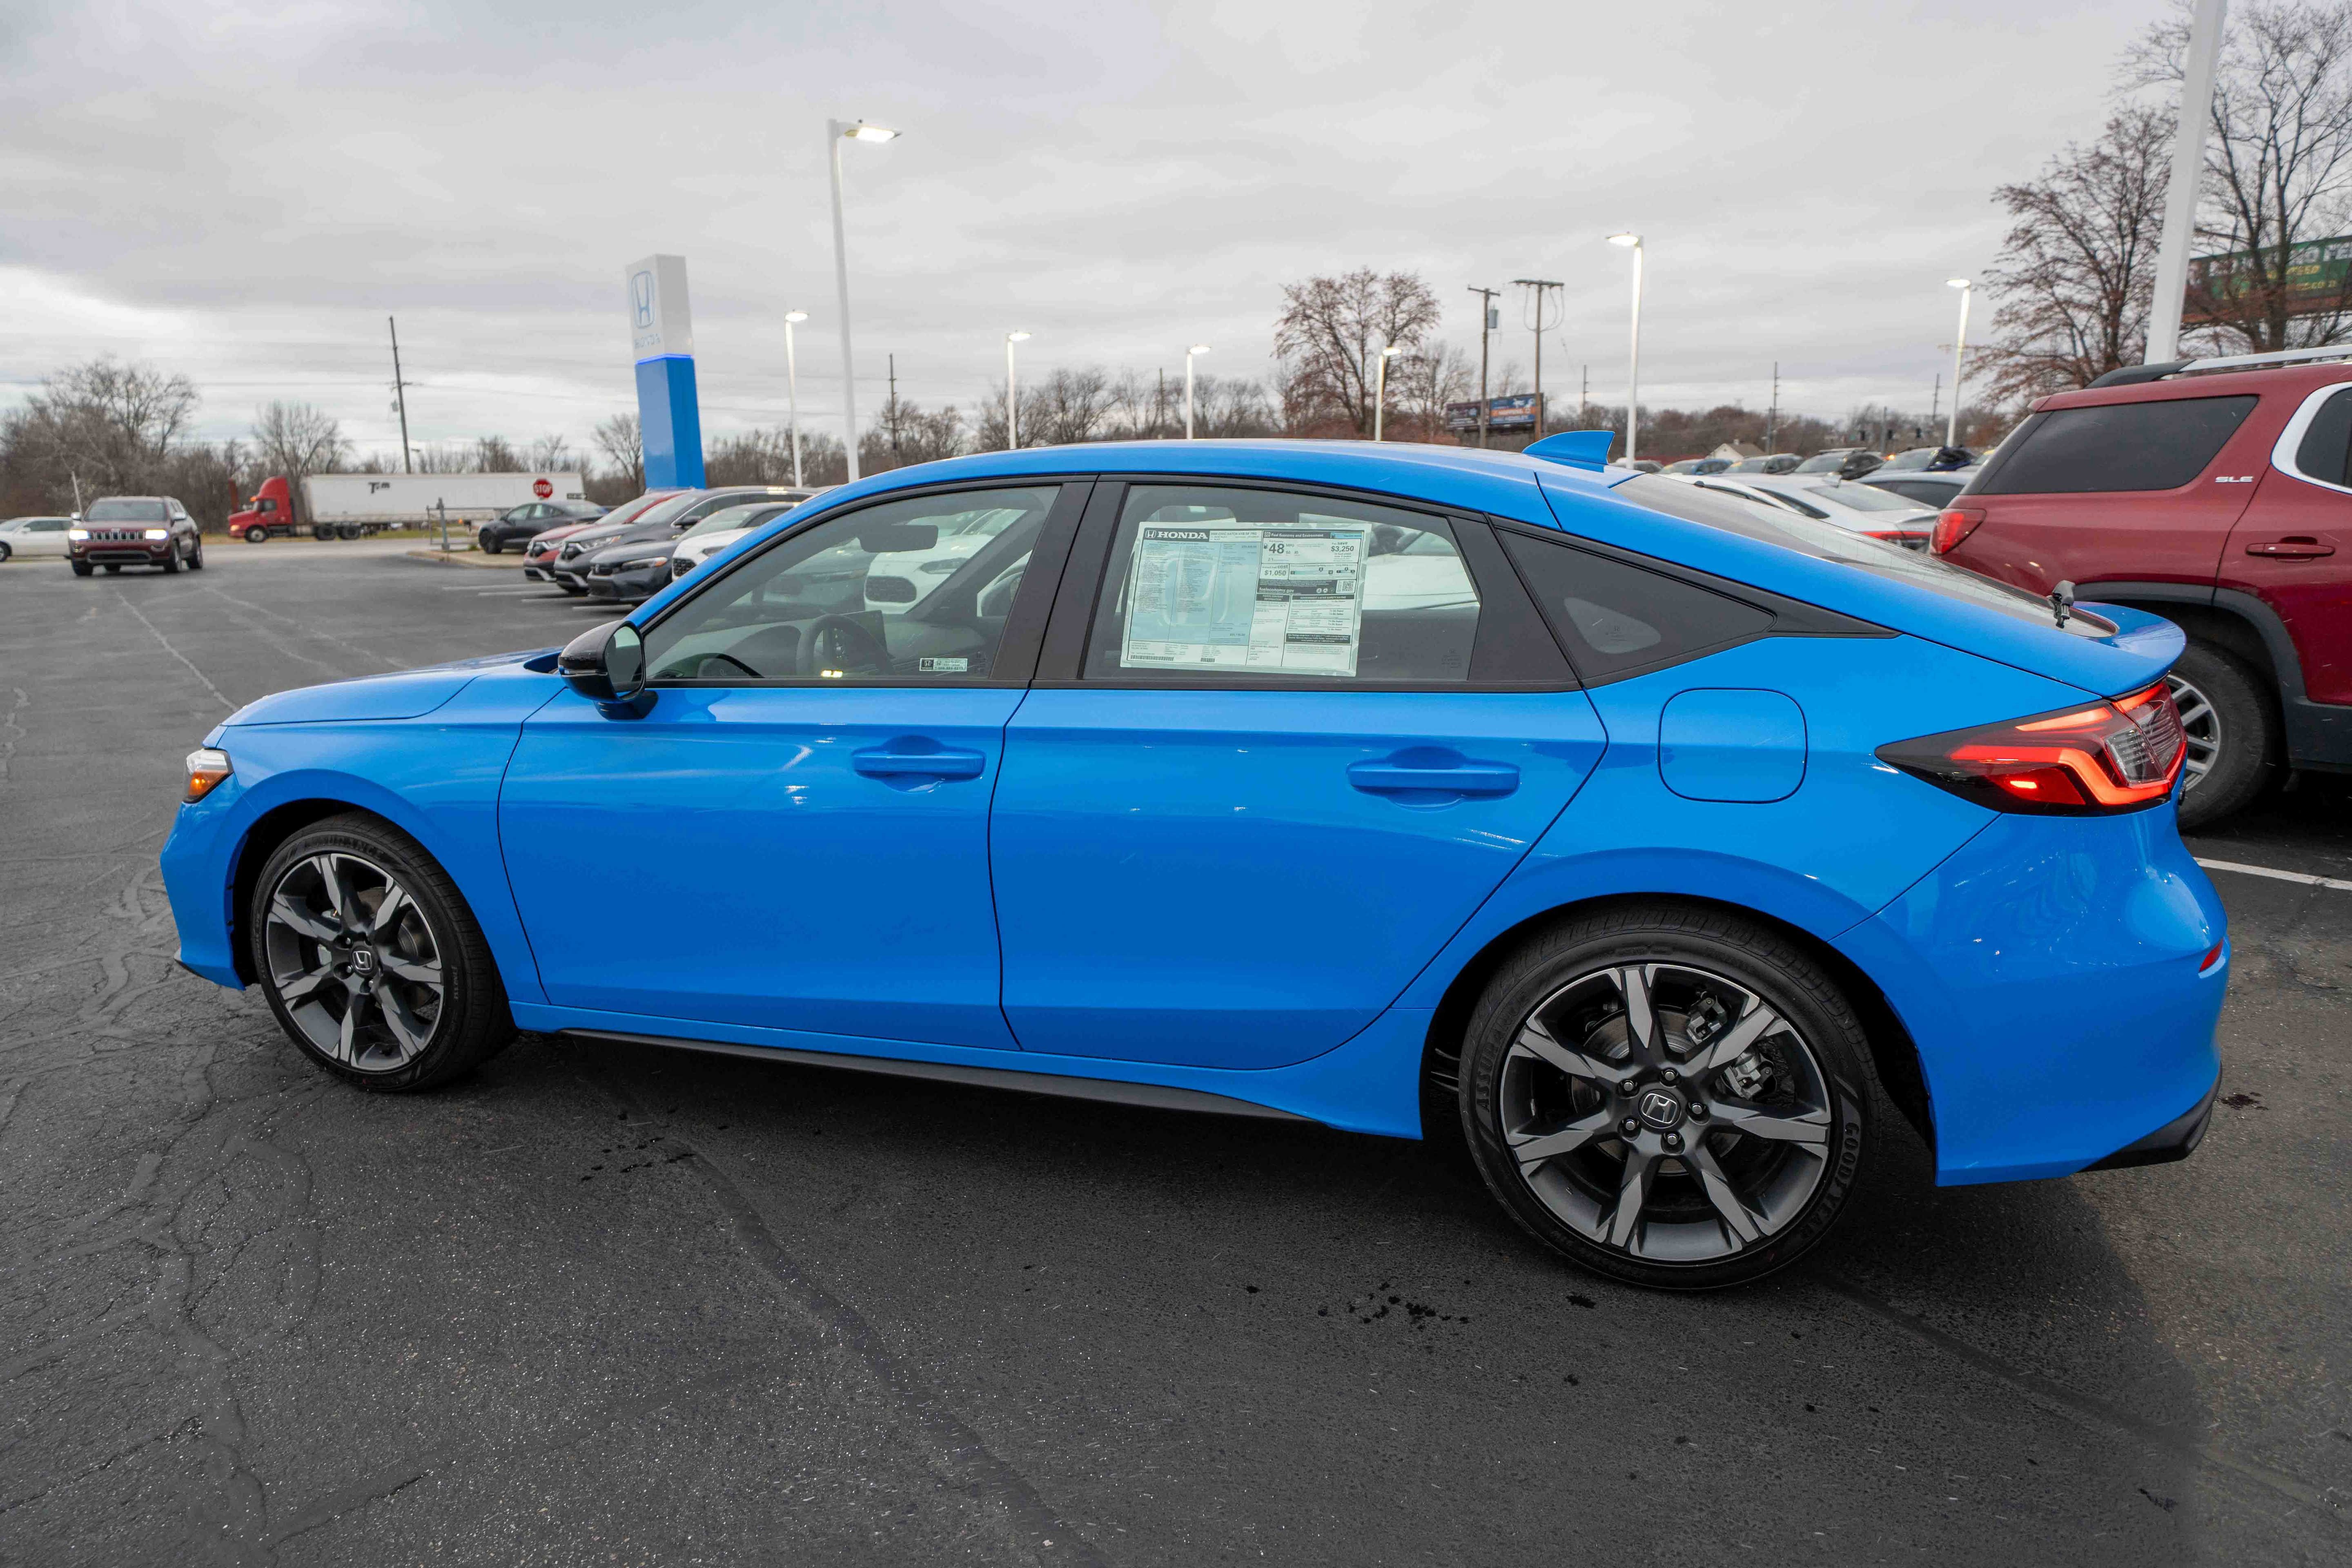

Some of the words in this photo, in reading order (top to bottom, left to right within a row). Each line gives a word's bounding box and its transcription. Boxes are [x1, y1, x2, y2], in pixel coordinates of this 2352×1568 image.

[535, 484, 552, 493] STOP
[1269, 543, 1284, 554] 48
[1800, 1121, 1860, 1238] GOODYEAR
